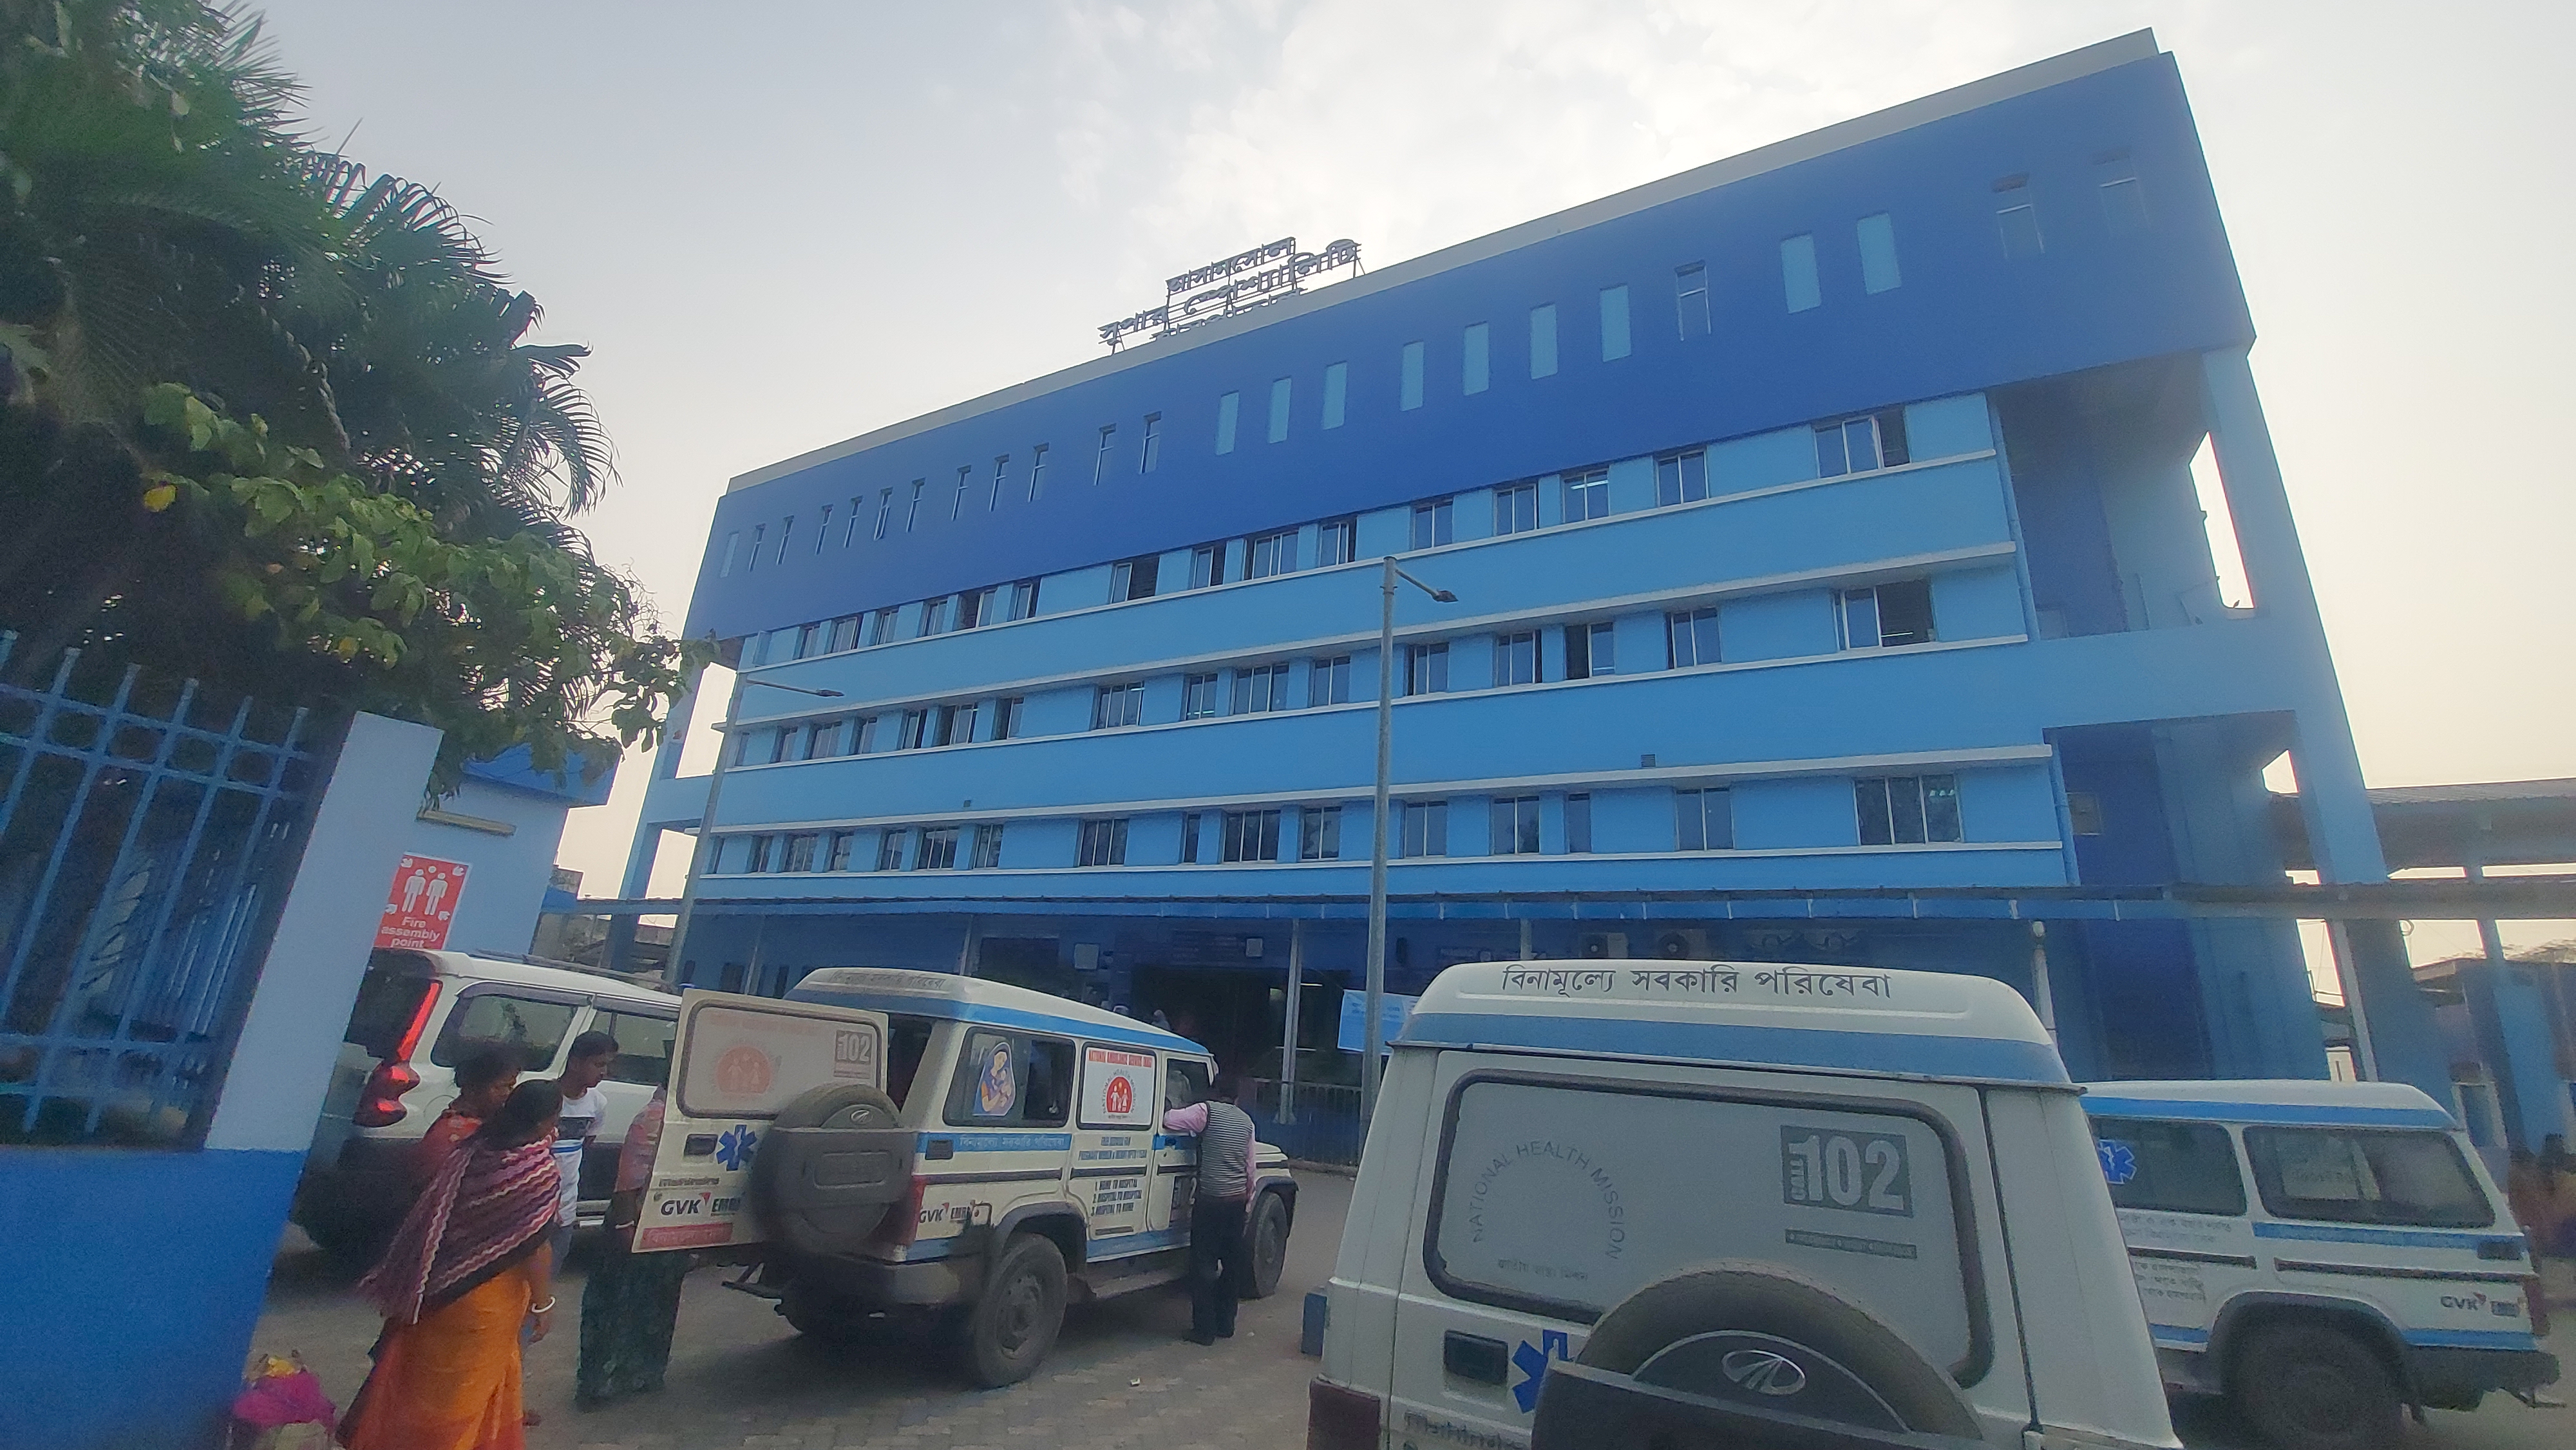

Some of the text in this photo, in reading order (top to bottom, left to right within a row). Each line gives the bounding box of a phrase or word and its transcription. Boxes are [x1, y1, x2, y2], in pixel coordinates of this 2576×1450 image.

[401, 916, 426, 928] Fire
[381, 927, 440, 942] assembly
[390, 938, 424, 948] point
[1502, 964, 1616, 997] বিনামূল্যে
[1754, 966, 1892, 998] পরিষেবা
[838, 1033, 870, 1062] 102
[1789, 1134, 1904, 1210] 102
[1469, 1140, 1625, 1259] NATIONAL HEALTH MISSION
[661, 1200, 701, 1216] GVK
[919, 1209, 943, 1223] GVK
